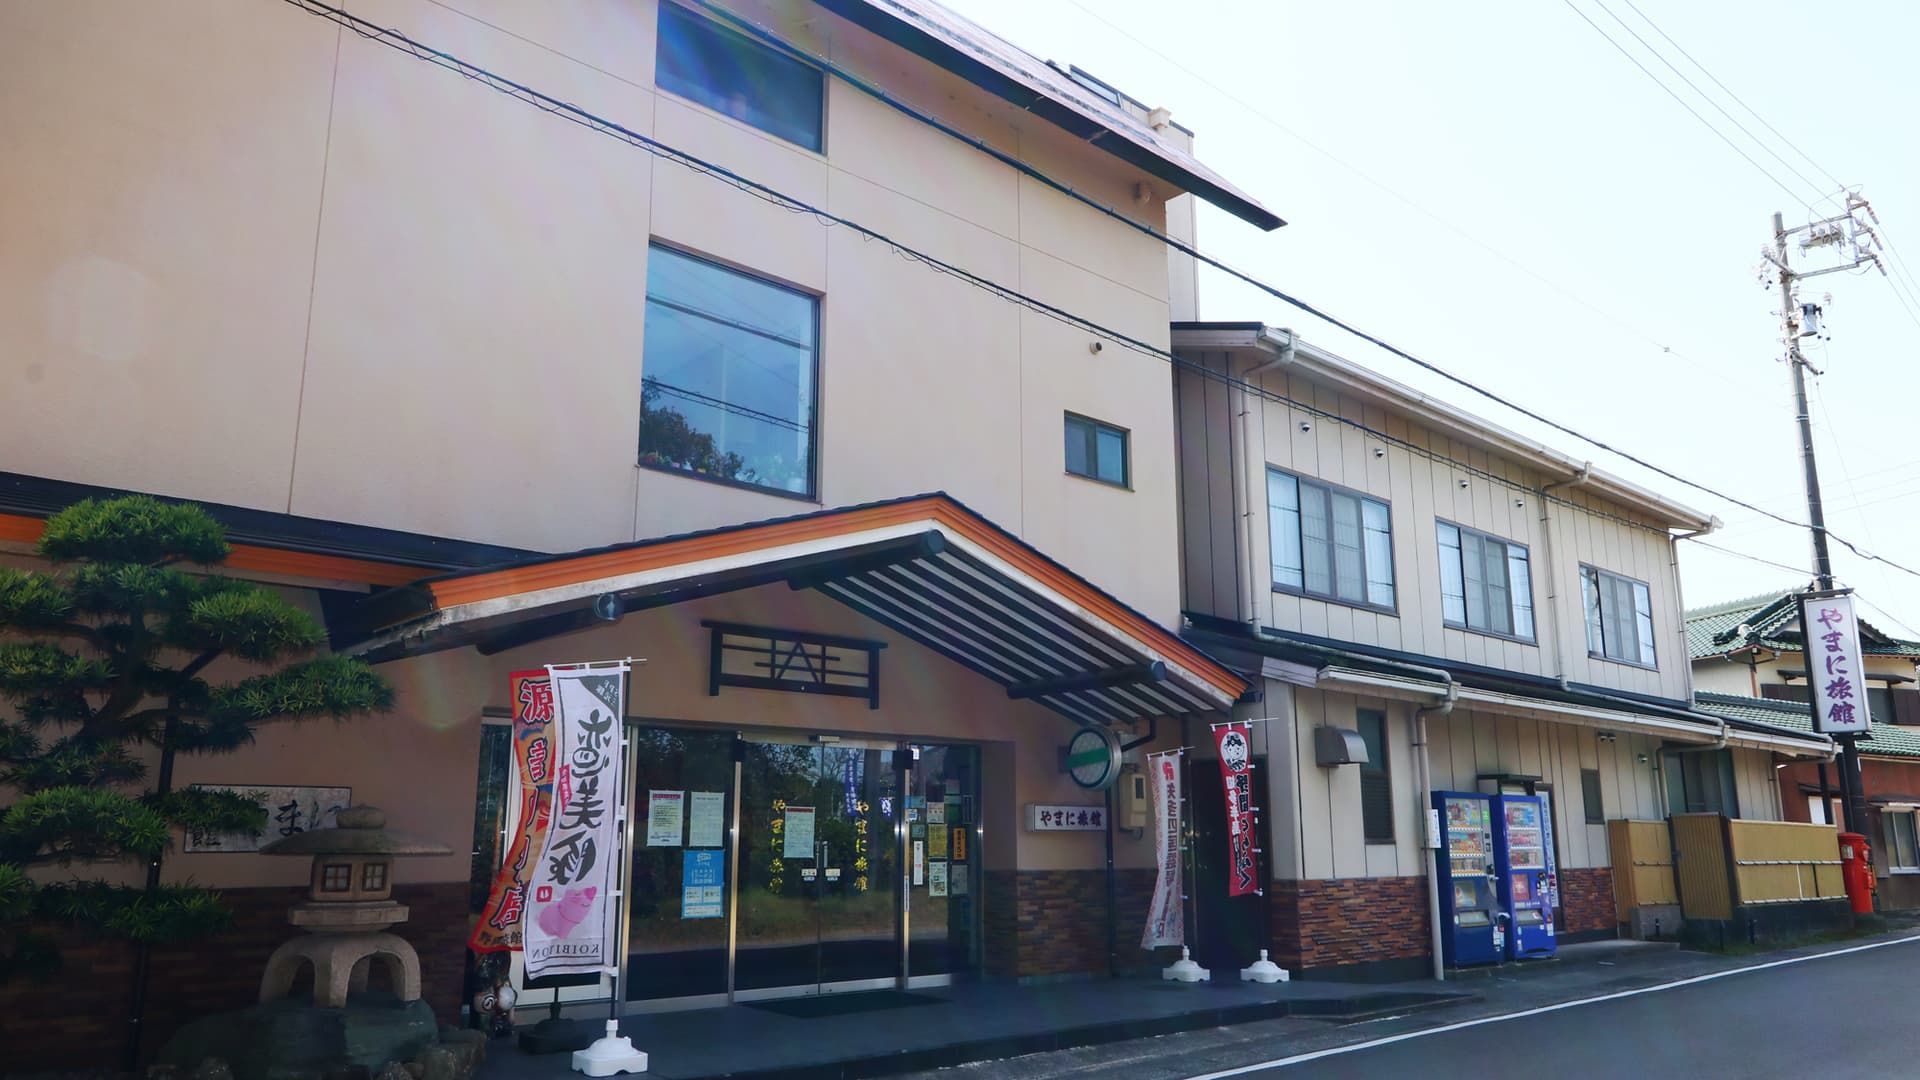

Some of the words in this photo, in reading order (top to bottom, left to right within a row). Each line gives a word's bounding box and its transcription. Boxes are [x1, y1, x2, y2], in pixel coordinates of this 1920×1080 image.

[1816, 608, 1857, 725] やまに旅館
[1040, 809, 1102, 828] やまに旅館
